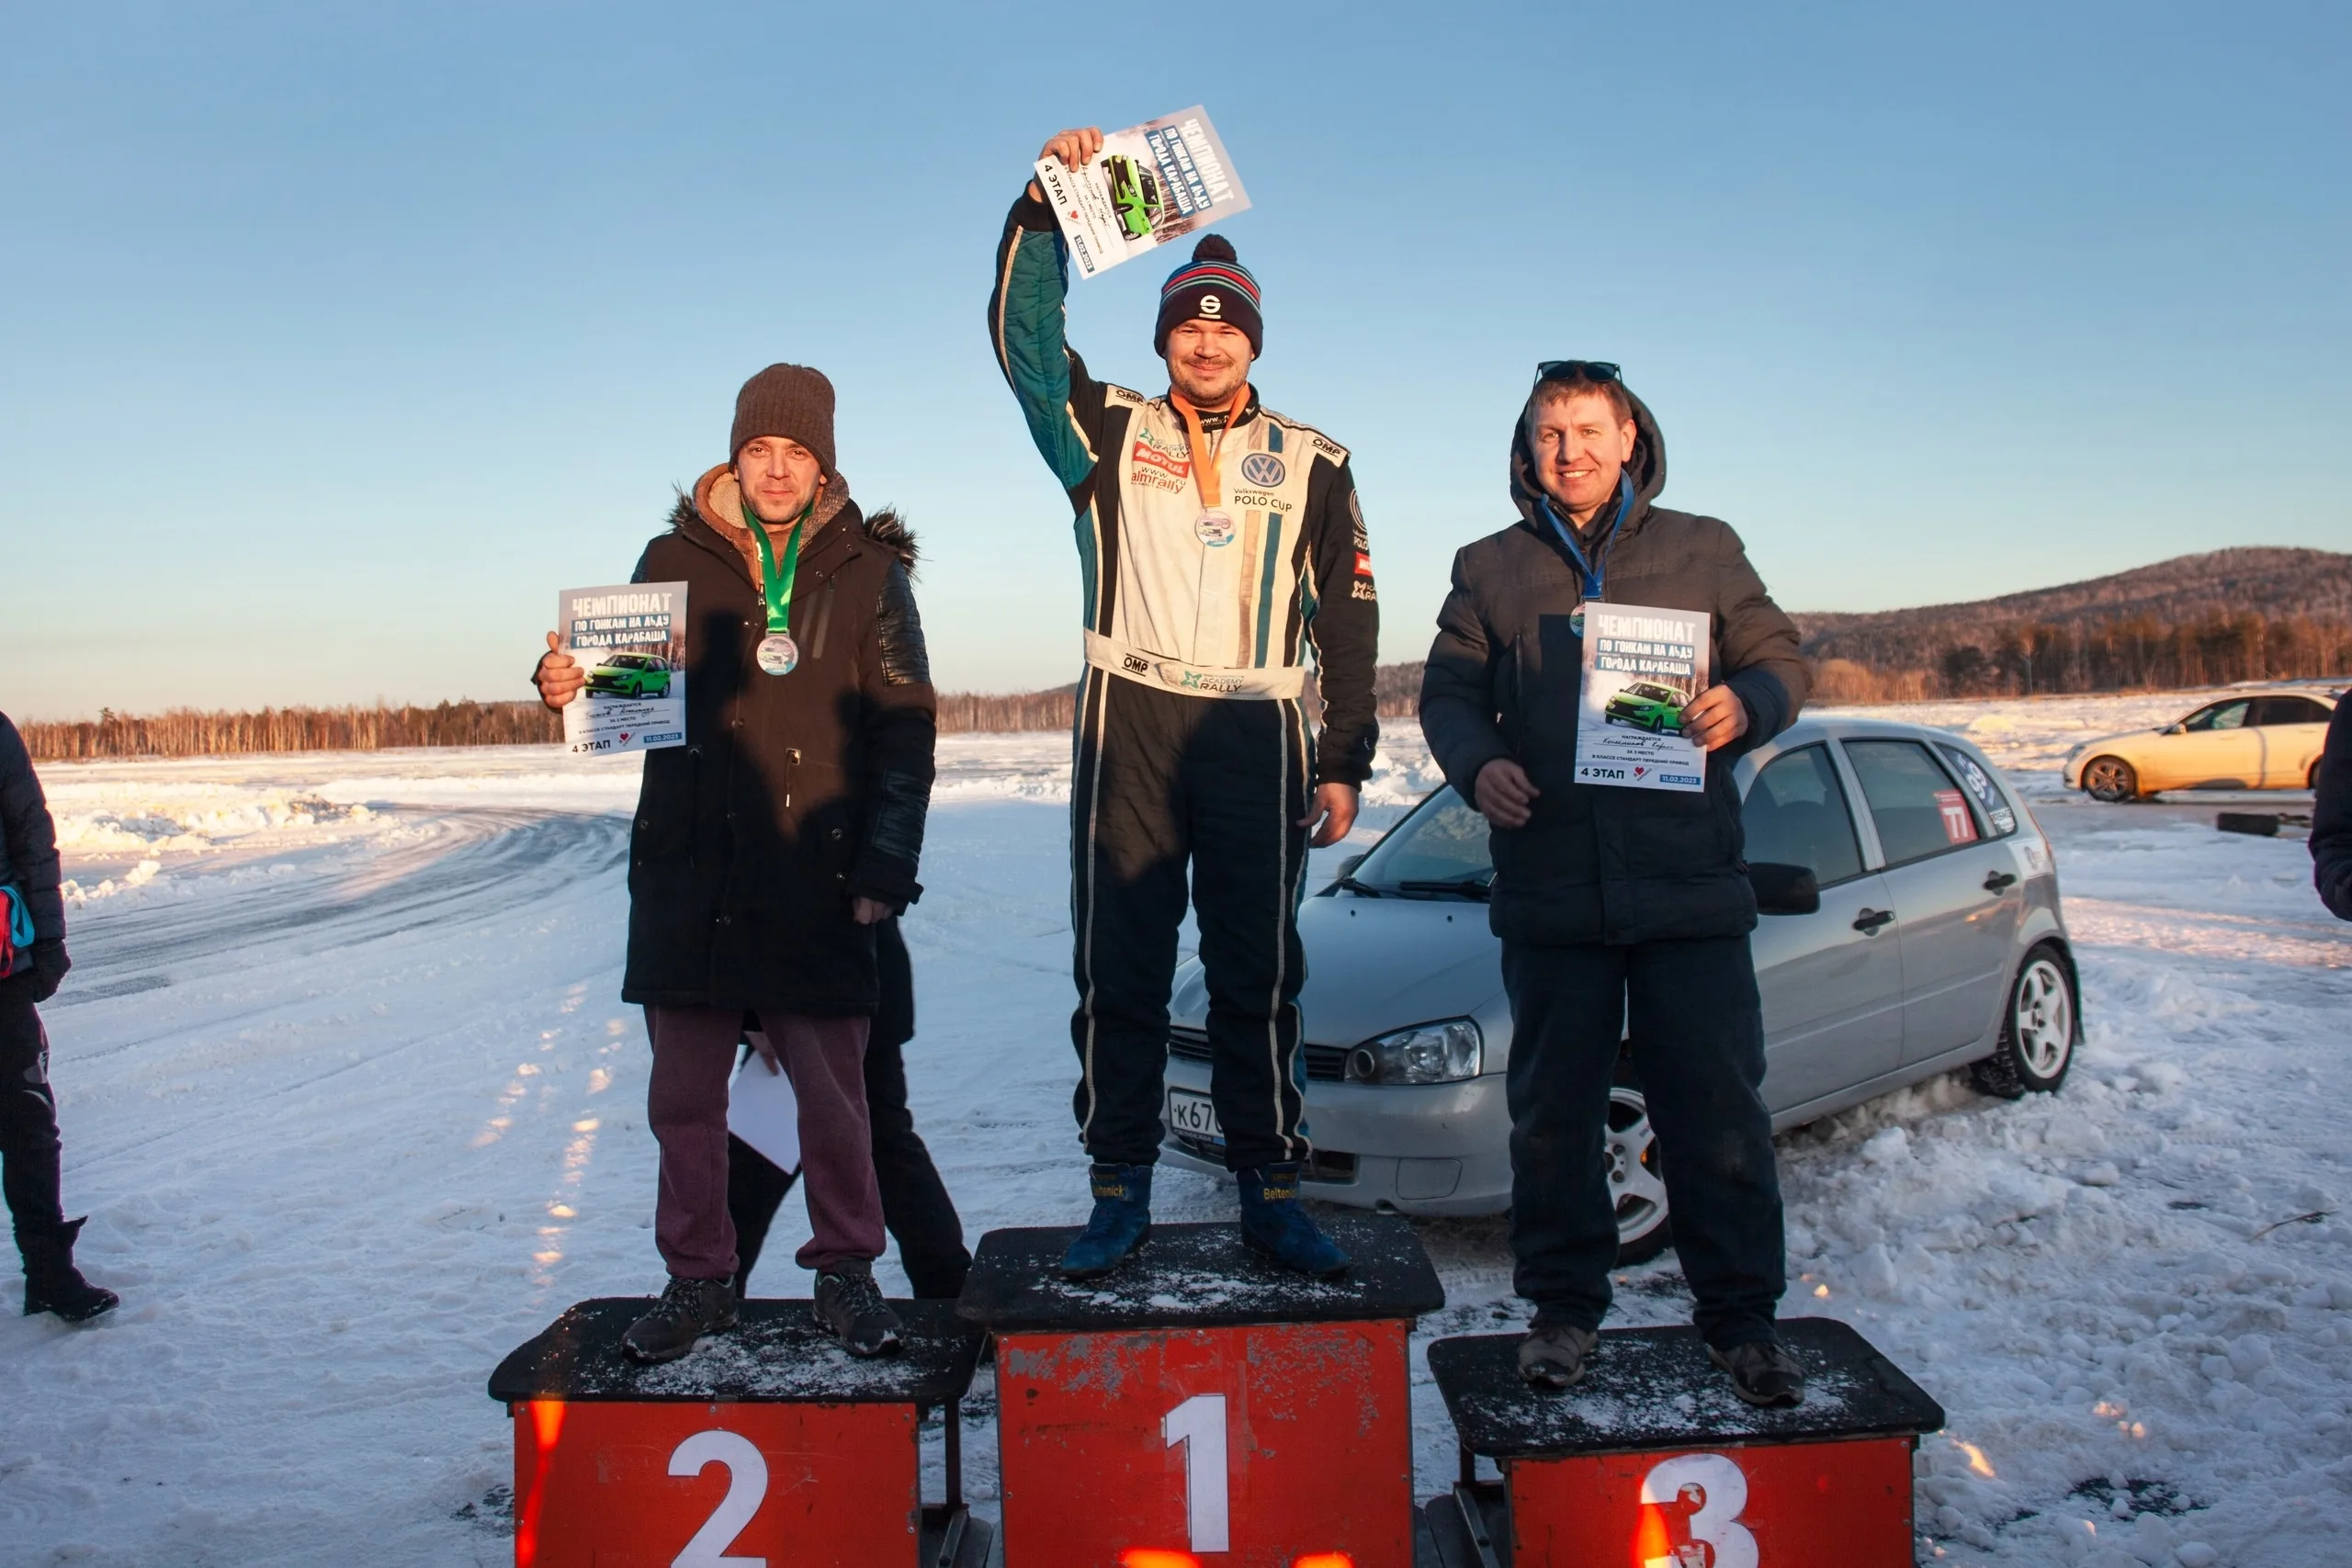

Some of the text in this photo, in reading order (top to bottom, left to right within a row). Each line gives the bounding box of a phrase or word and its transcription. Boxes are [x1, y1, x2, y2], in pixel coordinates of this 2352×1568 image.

[1164, 127, 1211, 209] ПО ГОНКАМ НА ЛЬДУ
[1180, 118, 1235, 203] ЧЕМПИОНАТ
[1148, 134, 1193, 215] ГОРОДА КАРАБАША
[1045, 164, 1068, 206] 4 ЭТАП
[1115, 389, 1144, 403] OMP
[1153, 445, 1190, 458] RALLY
[1312, 438, 1340, 455] OMP
[1136, 447, 1185, 474] MOTUL
[1131, 470, 1183, 494] almrally
[1234, 488, 1274, 496] Volkswagen
[1235, 495, 1293, 512] POLO CUP
[572, 592, 672, 618] ЧЕМПИОНАТ
[574, 615, 670, 632] ПО ГОНКАМ НА ЛЬДУ
[1598, 614, 1696, 643] ЧЕМПИОНАТ
[576, 630, 667, 647] ГОРОДА КАРАБАША
[1600, 639, 1693, 660] ПО ГОНКАМ НА ЛЬДУ
[1124, 656, 1148, 672] OMP
[1600, 657, 1690, 675] ГОРОДА КАРАБАША
[1199, 682, 1242, 693] RALLY
[572, 739, 611, 753] 4 ЭТАП
[646, 734, 679, 742] 11.02.2023
[1581, 768, 1589, 776] 4
[1592, 768, 1624, 780] ЭТАП
[1662, 775, 1697, 784] 11.02.2023
[1943, 807, 1969, 839] 77
[1164, 1393, 1230, 1554] 1
[667, 1428, 770, 1568] 2
[1640, 1452, 1759, 1568] 3
